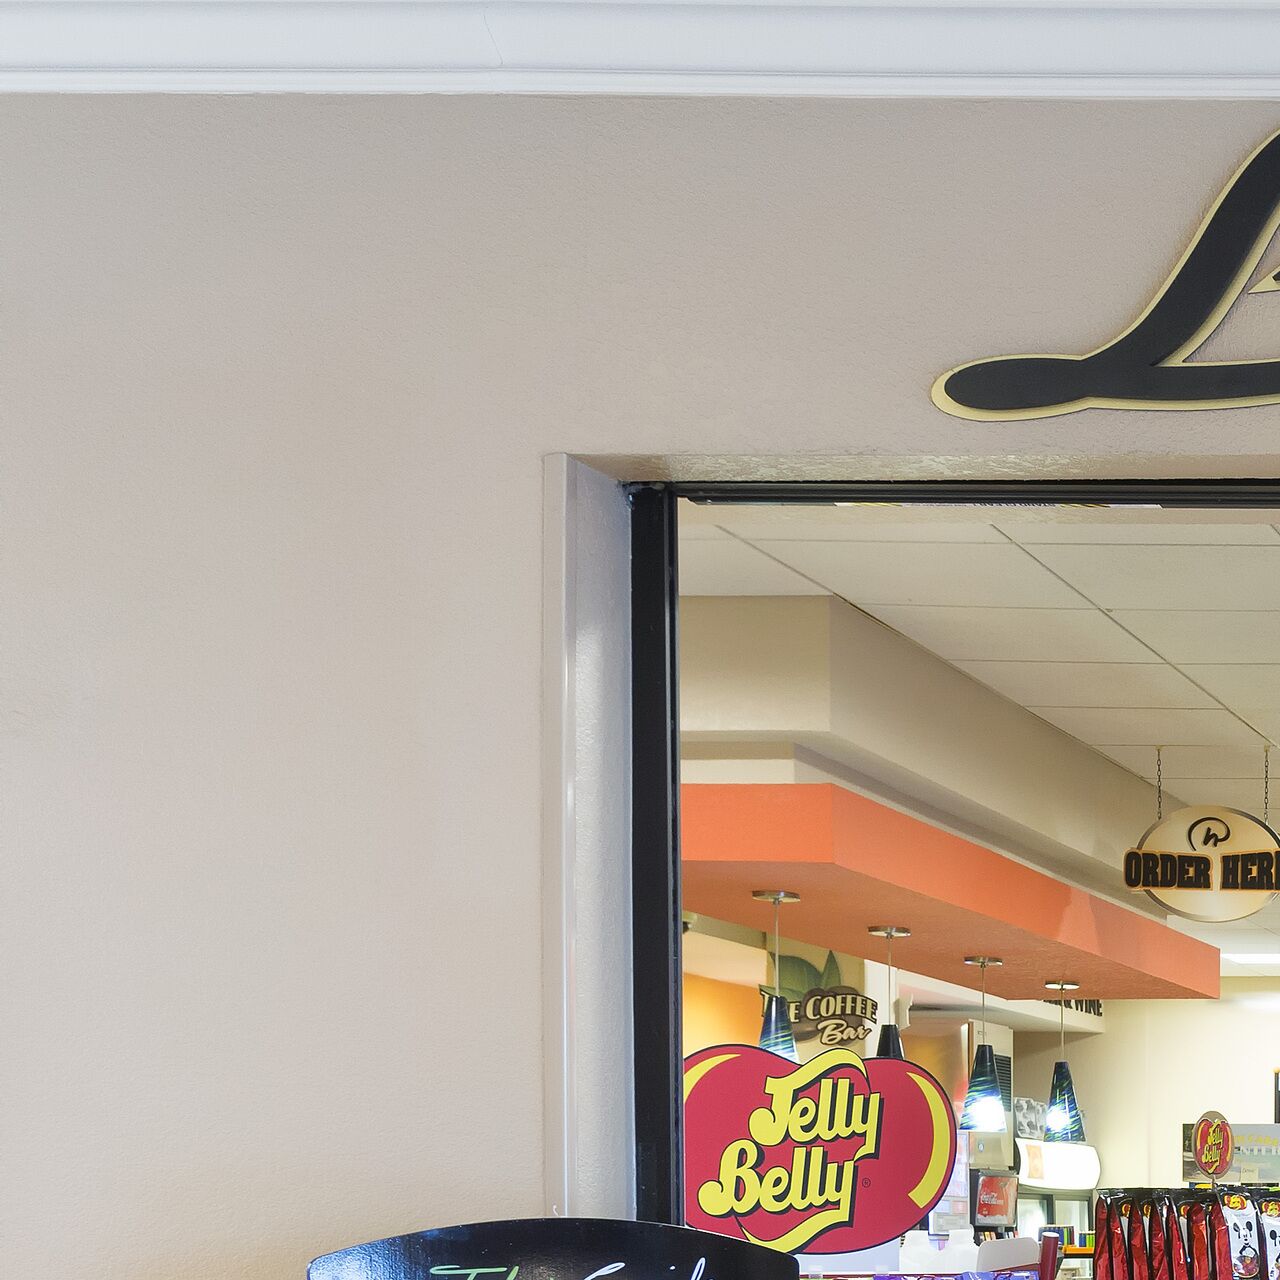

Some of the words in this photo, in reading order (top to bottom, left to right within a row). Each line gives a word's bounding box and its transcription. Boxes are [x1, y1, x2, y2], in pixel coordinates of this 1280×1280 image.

[1124, 850, 1213, 890] ORDER
[760, 990, 801, 1023] TE
[804, 993, 878, 1025] COFFEE
[817, 1018, 872, 1045] Bar
[748, 1056, 881, 1160] Jelly
[1207, 1120, 1224, 1148] Jelly
[1201, 1142, 1221, 1165] Belly
[698, 1138, 861, 1238] Belly
